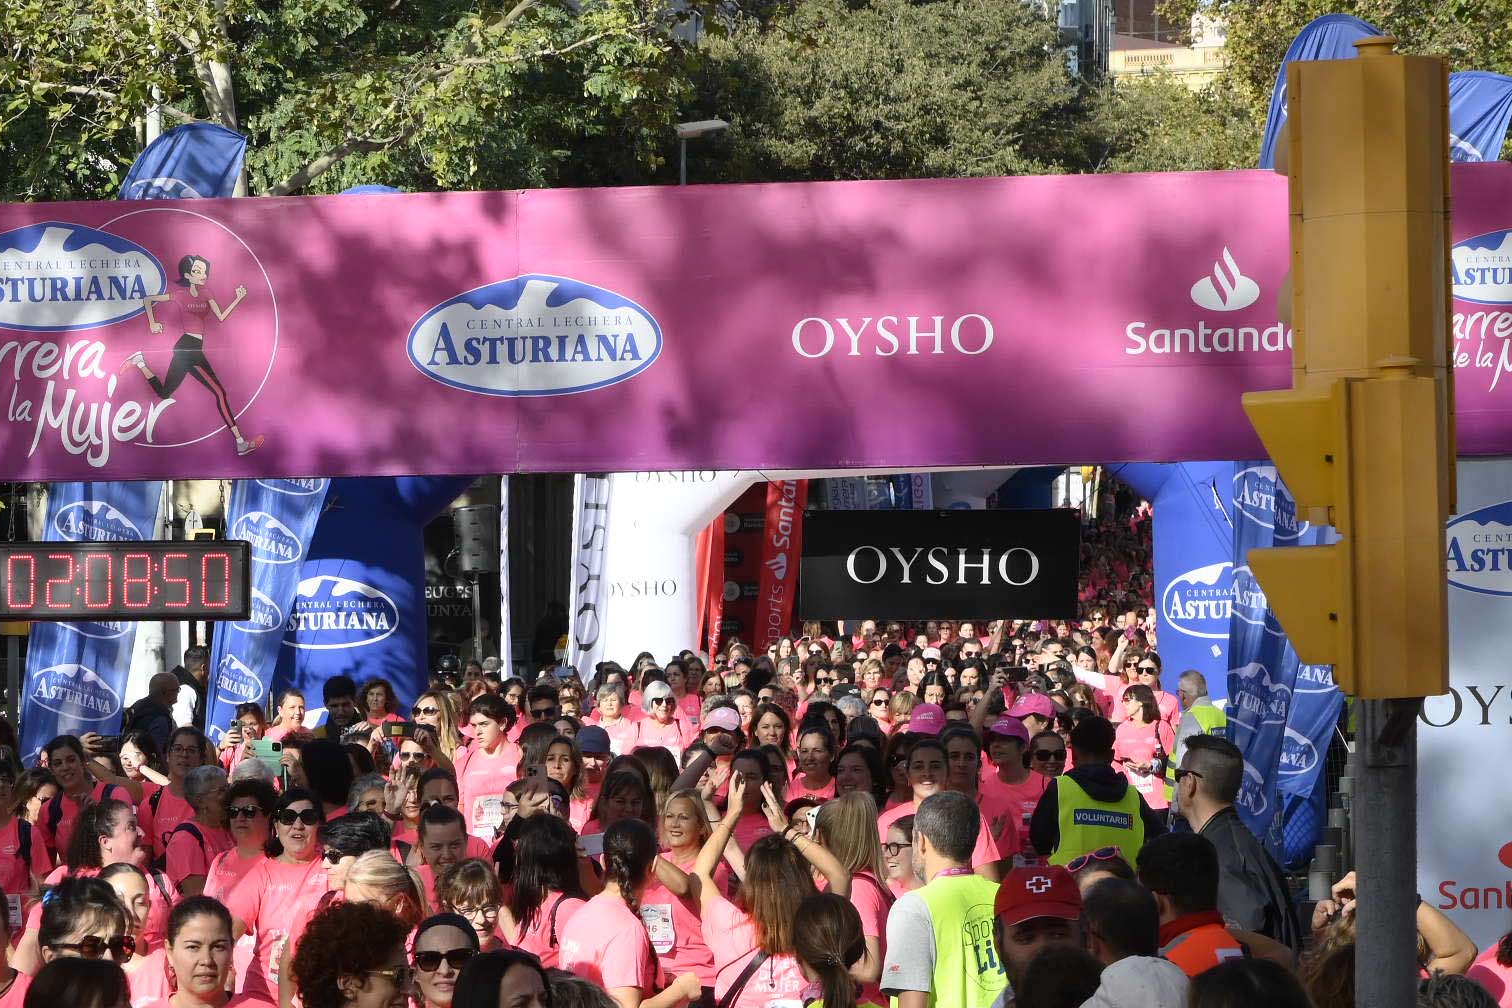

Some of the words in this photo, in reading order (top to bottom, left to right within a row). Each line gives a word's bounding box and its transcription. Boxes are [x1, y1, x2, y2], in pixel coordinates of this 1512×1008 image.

[70, 258, 141, 270] LECHERA
[466, 316, 542, 330] CENTRAL
[553, 314, 634, 328] LECHERA
[792, 314, 994, 358] OYSHO
[427, 322, 641, 366] ASTURIANA
[8, 383, 32, 422] la
[28, 374, 176, 468] Mujer
[7, 554, 230, 608] 02:08:50
[847, 544, 1040, 587] OYSHO
[34, 677, 112, 714] ASTURIANA
[1418, 685, 1512, 727] OY
[1075, 811, 1128, 827] VOLUNTARIS
